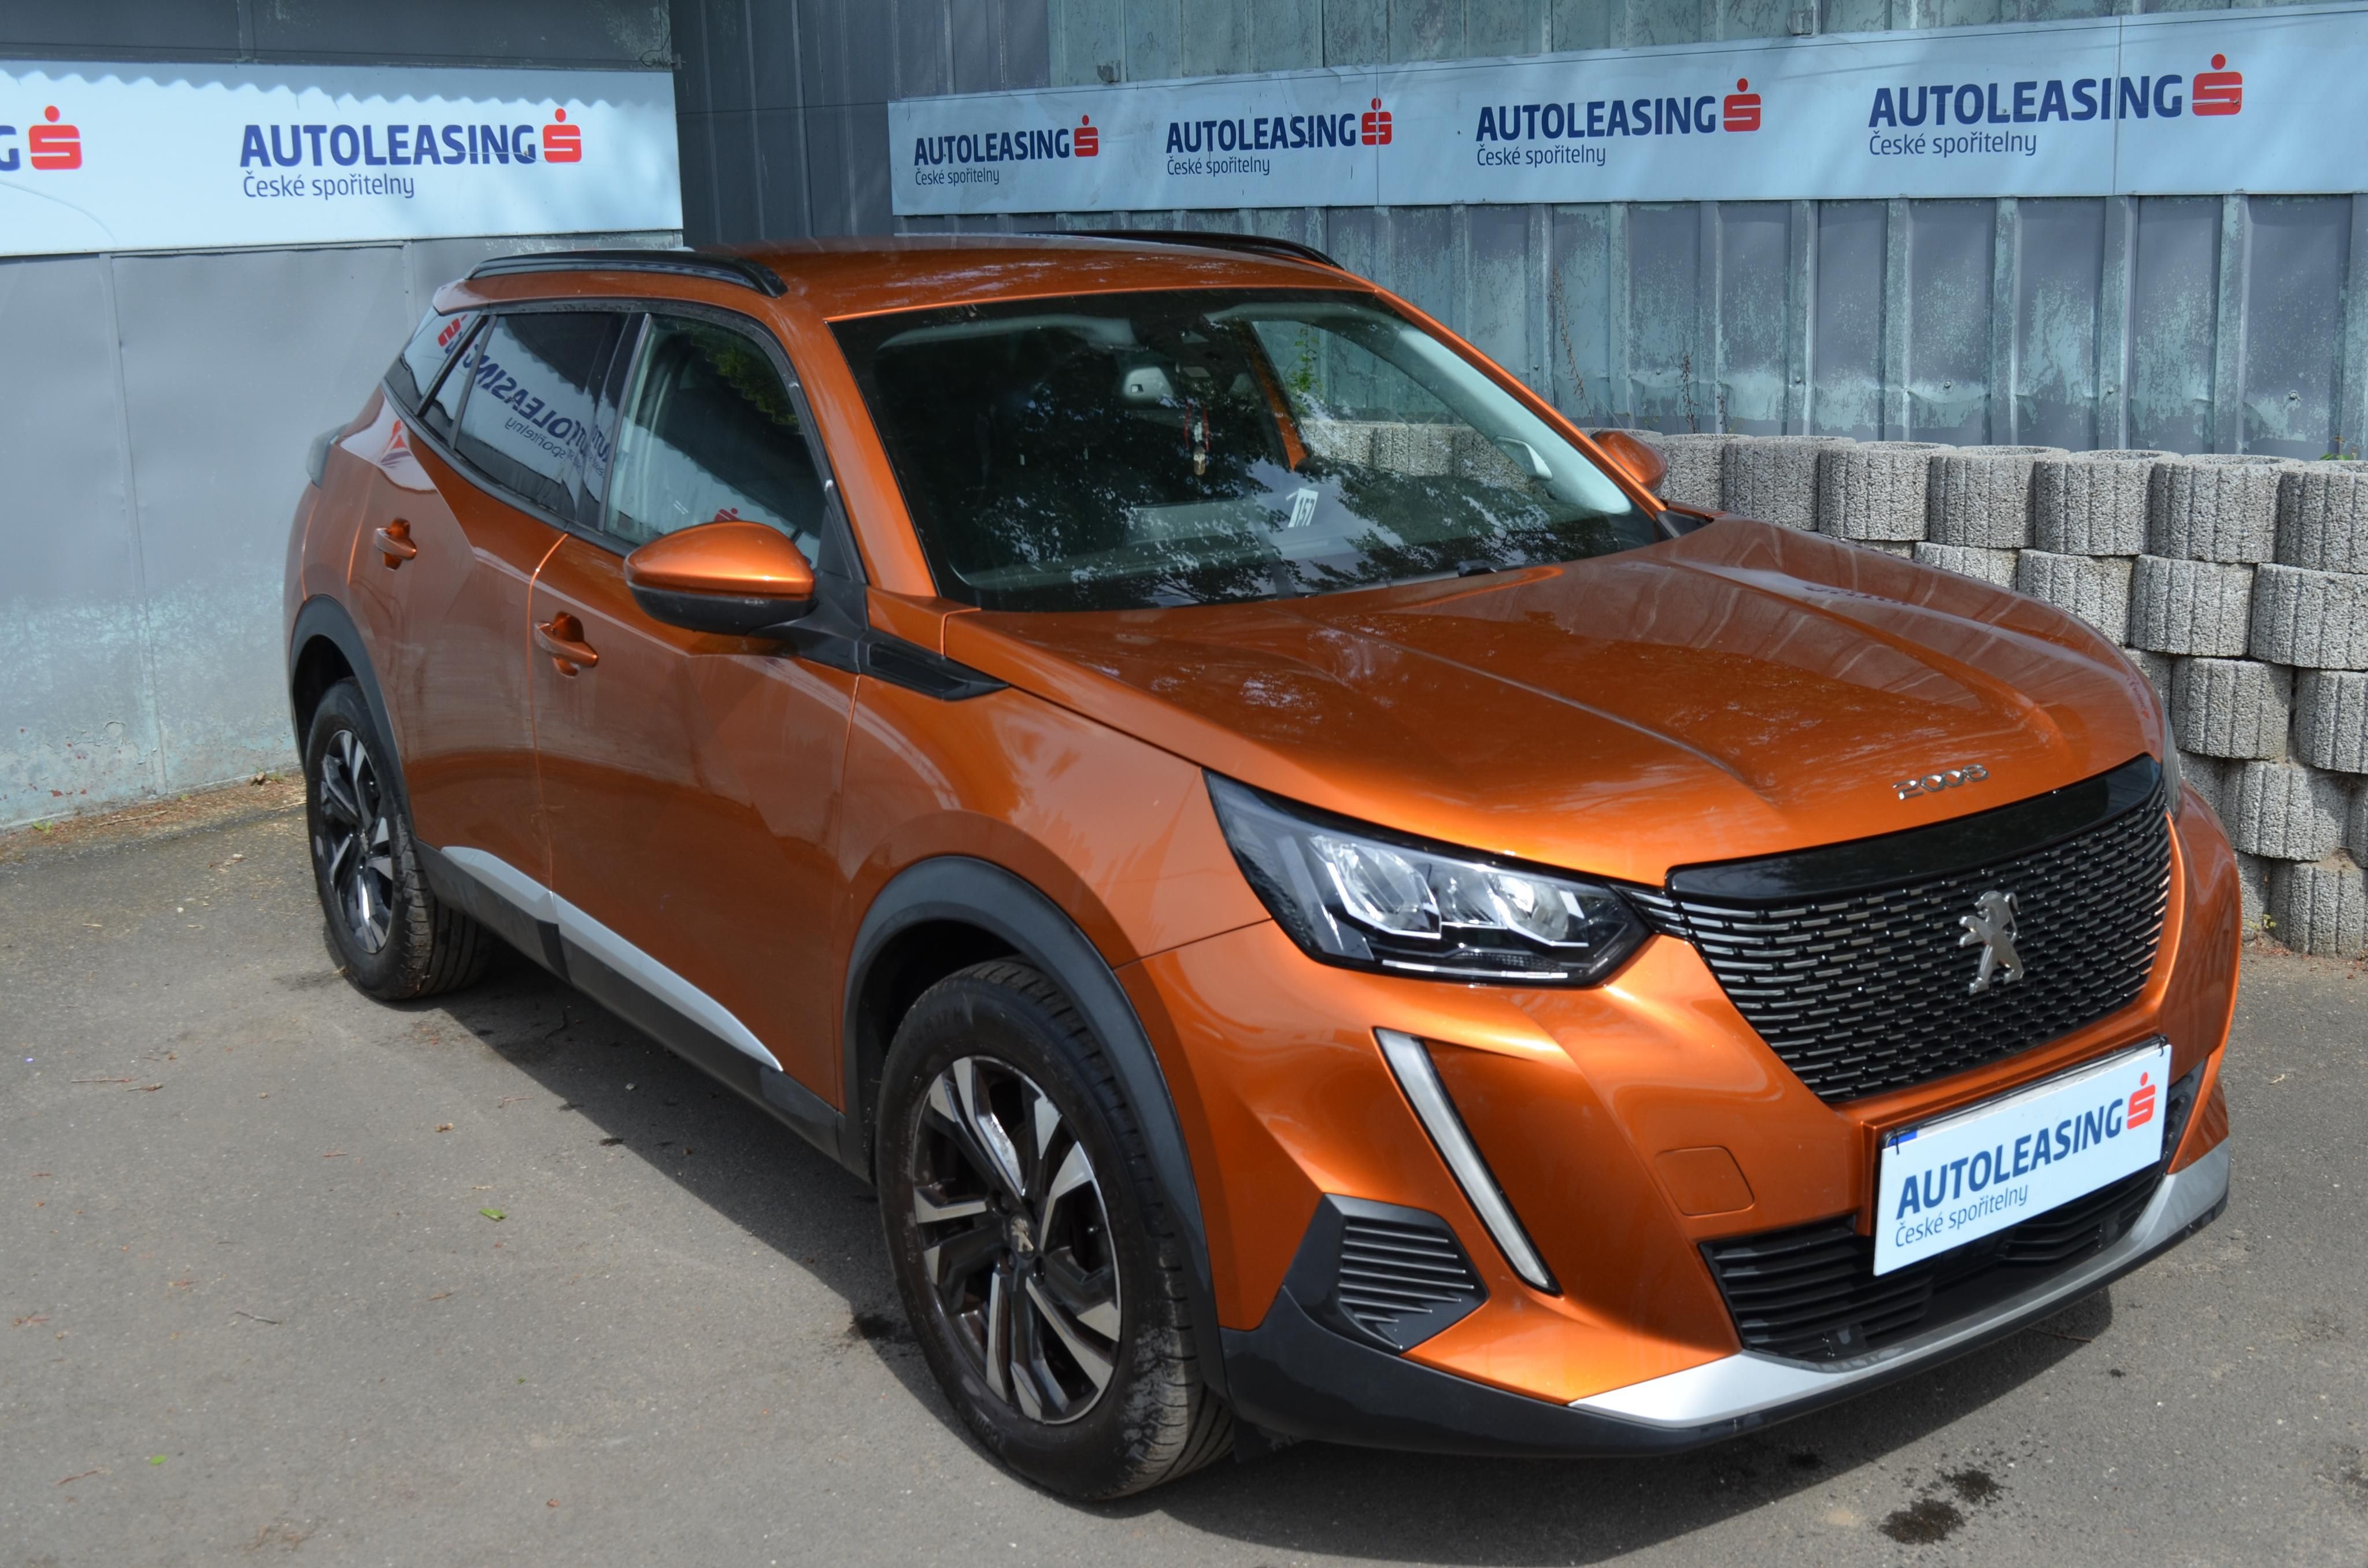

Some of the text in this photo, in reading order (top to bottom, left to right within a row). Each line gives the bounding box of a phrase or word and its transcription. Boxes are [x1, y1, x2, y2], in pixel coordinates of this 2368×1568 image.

[1475, 96, 1716, 141] AUTOLEASING
[1868, 75, 2183, 127] AUTOLEASING
[240, 124, 536, 167] AUTOLEASING
[914, 128, 1070, 166] AUTOLEASING
[1166, 113, 1356, 153] AUTOLEASING
[1869, 131, 2037, 158] České spořitelny
[1167, 156, 1270, 177] České spořitelny
[1477, 144, 1606, 168] České spořitelny
[243, 170, 415, 201] České spořitelny
[915, 167, 1000, 187] České spořitelny
[1892, 763, 1989, 800] 2008
[1896, 1098, 2123, 1220] AUTOLEASING
[1895, 1184, 2028, 1248] České spořitelny
